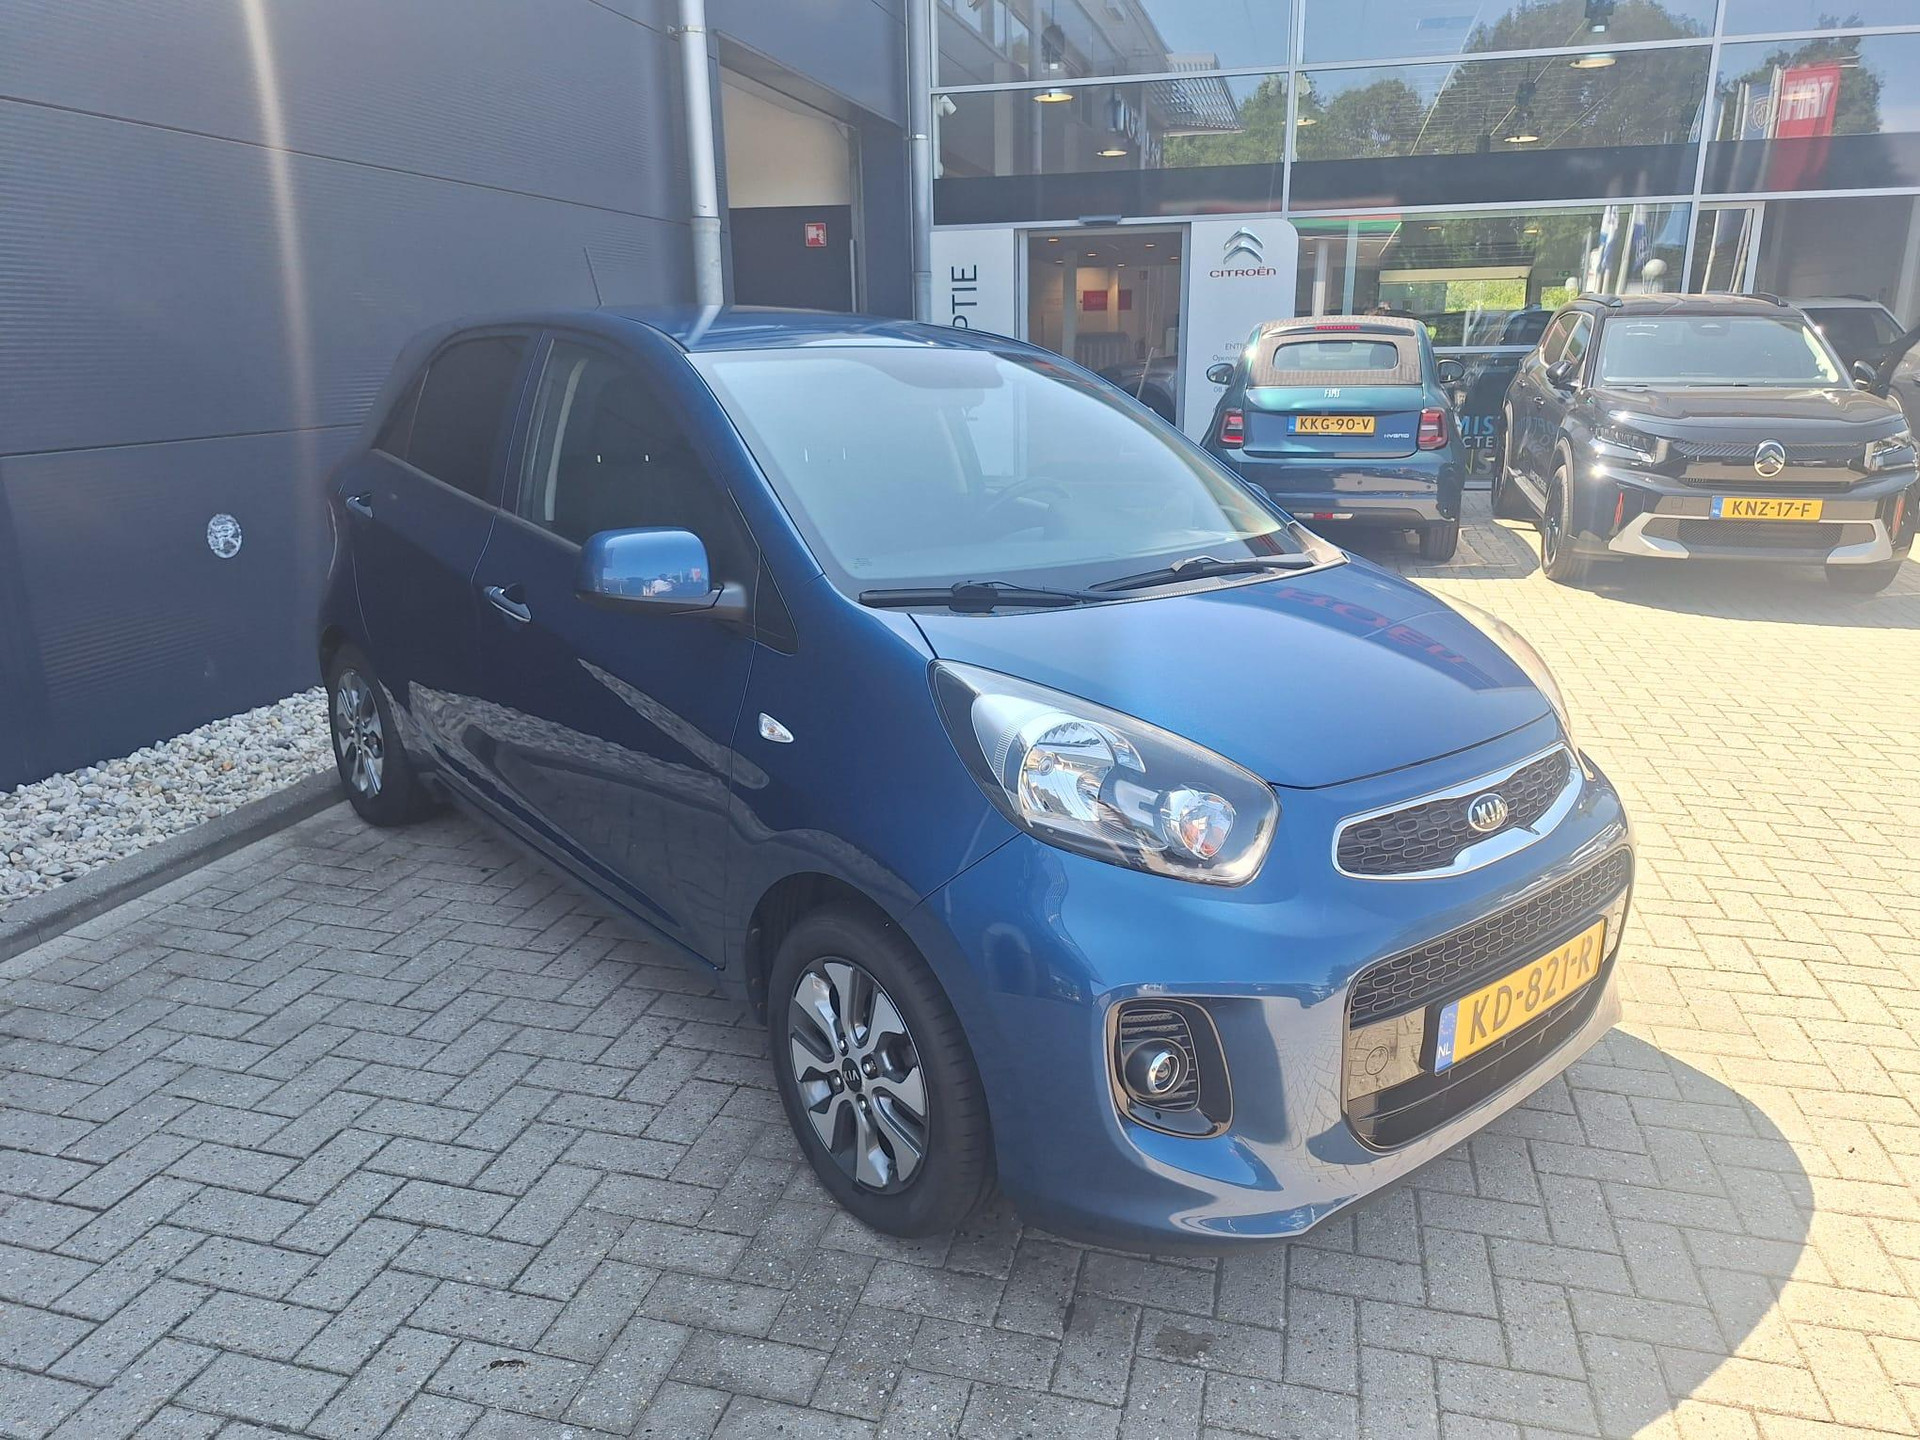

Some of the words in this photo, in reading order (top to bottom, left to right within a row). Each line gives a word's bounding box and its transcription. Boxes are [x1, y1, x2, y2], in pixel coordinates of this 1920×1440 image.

[1324, 388, 1341, 398] FIAT
[1300, 418, 1371, 431] KKG-90-V
[1731, 501, 1812, 517] KNZ-17-F
[1475, 799, 1506, 826] KIA
[1469, 934, 1594, 1045] KD-821-R
[1437, 1042, 1452, 1058] NL
[842, 1069, 861, 1081] KIA
